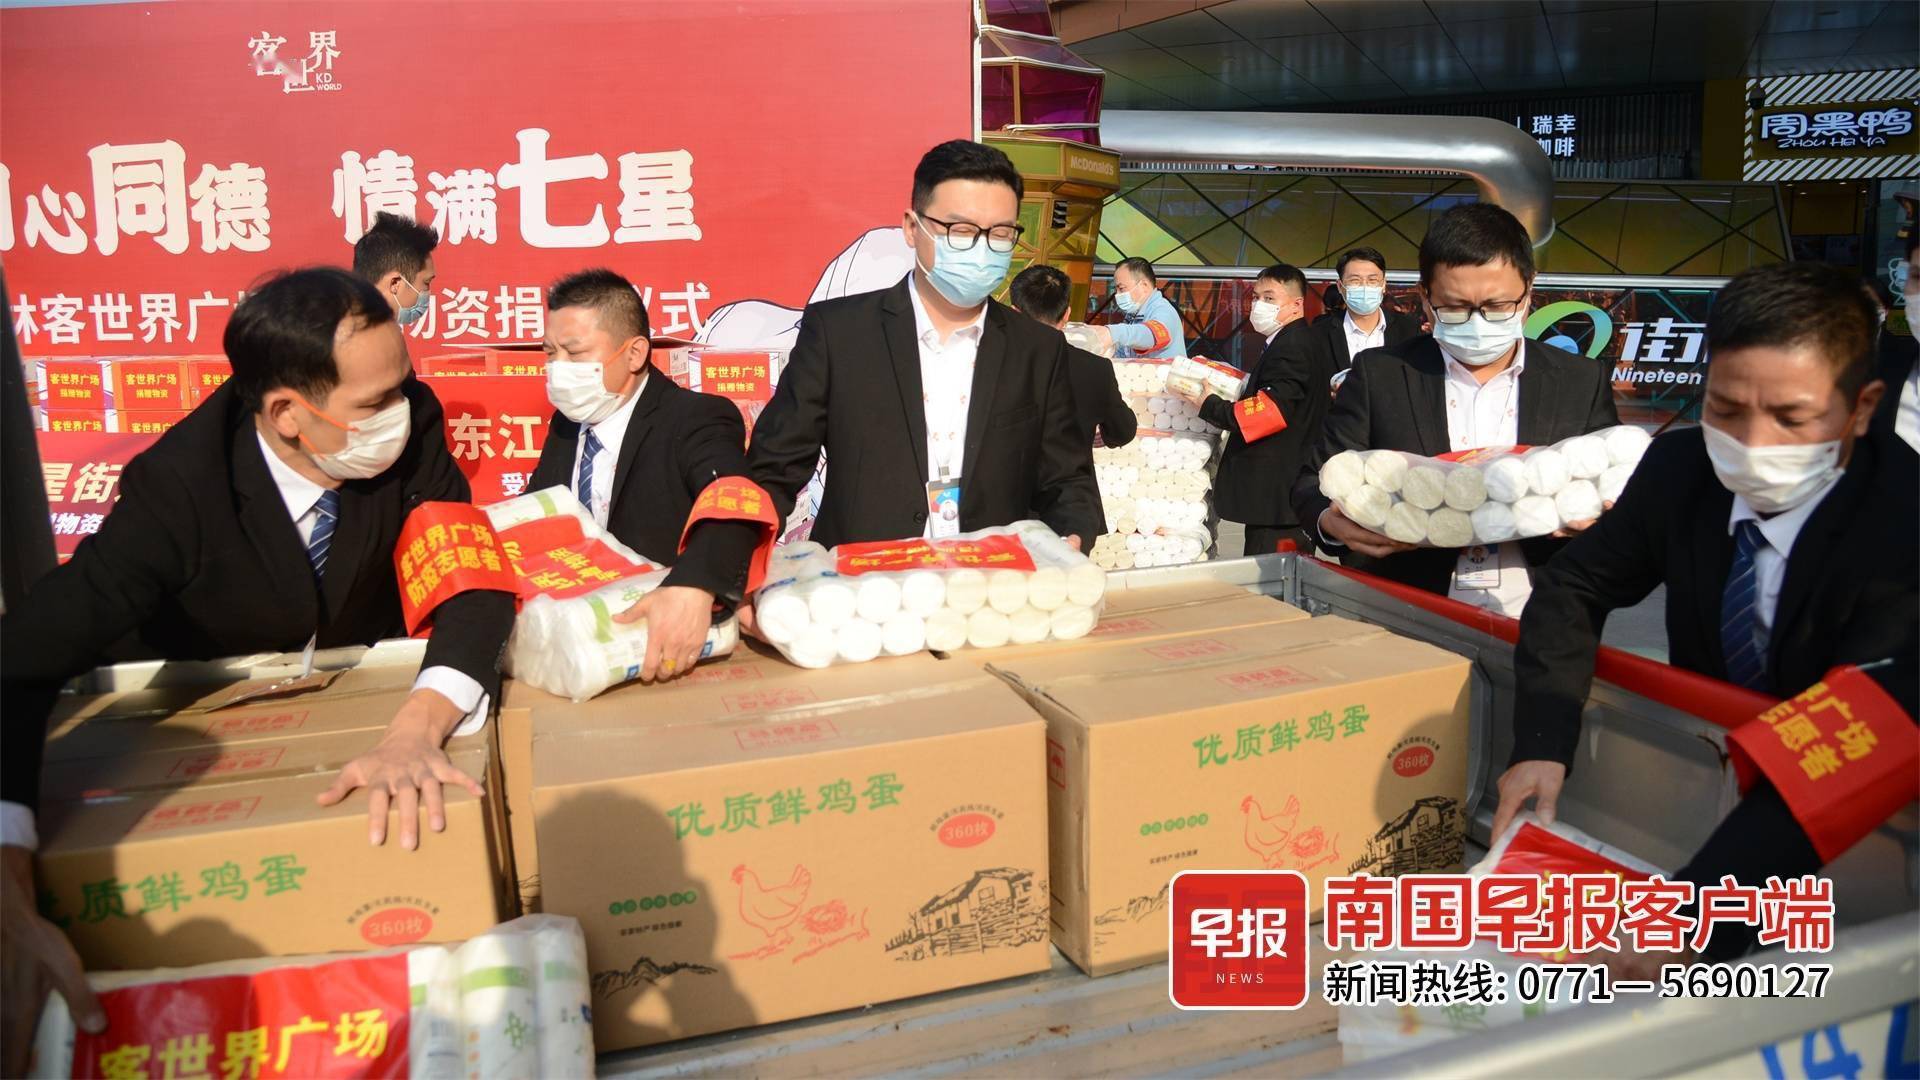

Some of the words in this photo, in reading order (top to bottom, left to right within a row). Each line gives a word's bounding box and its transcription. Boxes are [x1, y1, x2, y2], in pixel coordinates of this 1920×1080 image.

[316, 73, 333, 83] KD
[1532, 114, 1576, 135] 瑞幸
[1761, 108, 1912, 139] 周黑鸭
[0, 139, 271, 256] 心同德
[332, 128, 702, 248] 情满七星
[10, 291, 245, 344] 客世界广
[409, 282, 710, 340] 资捐式
[1619, 317, 1708, 364] 街
[50, 373, 100, 386] 客世界广场
[125, 374, 177, 386] 客世界广场
[705, 366, 766, 379] 客世界广场
[1611, 367, 1701, 385] Nineteen
[717, 382, 756, 393] 捐赠物资
[52, 420, 103, 432] 客世界广场
[448, 412, 552, 461] 东江
[41, 462, 124, 504] 星街
[501, 472, 533, 497] 受
[50, 512, 104, 535] 物资
[401, 523, 494, 581] 客世界广场
[1192, 704, 1371, 769] 优质鲜鸡蛋
[667, 772, 905, 841] 优质鲜鸡蛋
[943, 820, 991, 842] 360枚
[368, 915, 427, 939] 360枚
[100, 1008, 390, 1080] 客世界广场
